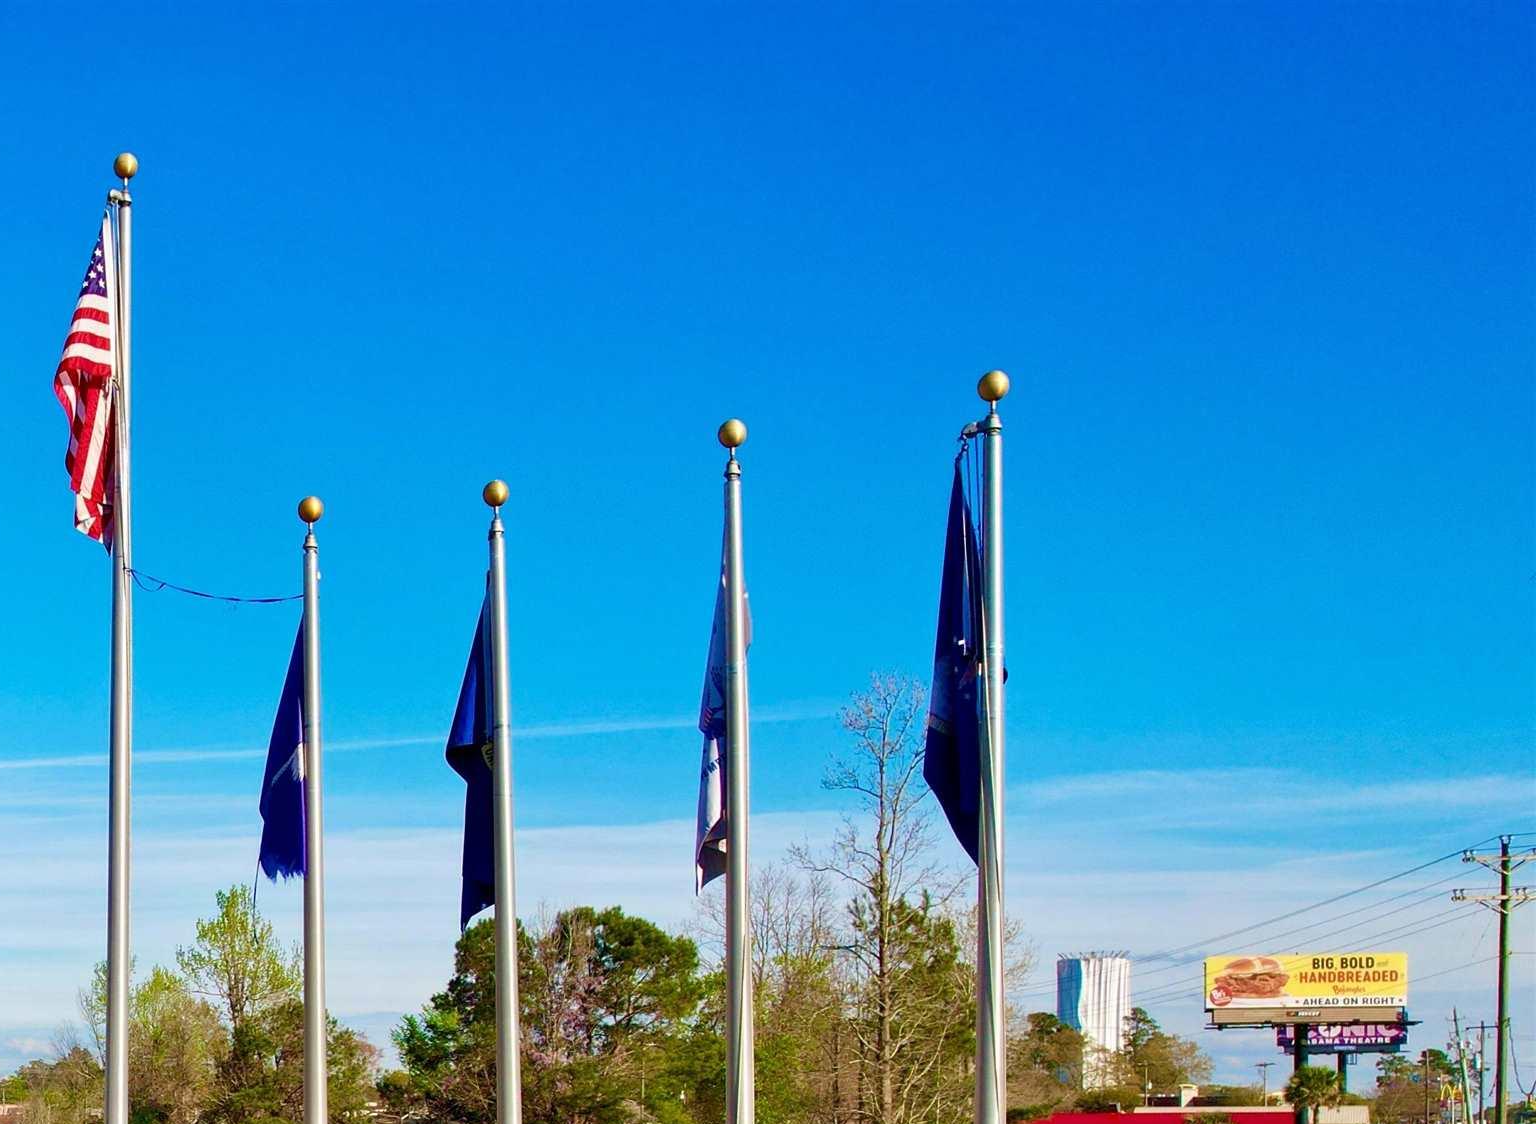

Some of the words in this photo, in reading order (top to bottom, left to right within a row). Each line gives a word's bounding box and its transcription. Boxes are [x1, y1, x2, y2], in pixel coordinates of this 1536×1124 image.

[1340, 956, 1375, 969] BOLD
[1299, 970, 1398, 983] HANDBREADED
[1344, 997, 1358, 1005] ON
[1344, 1036, 1391, 1044] THEATRE
